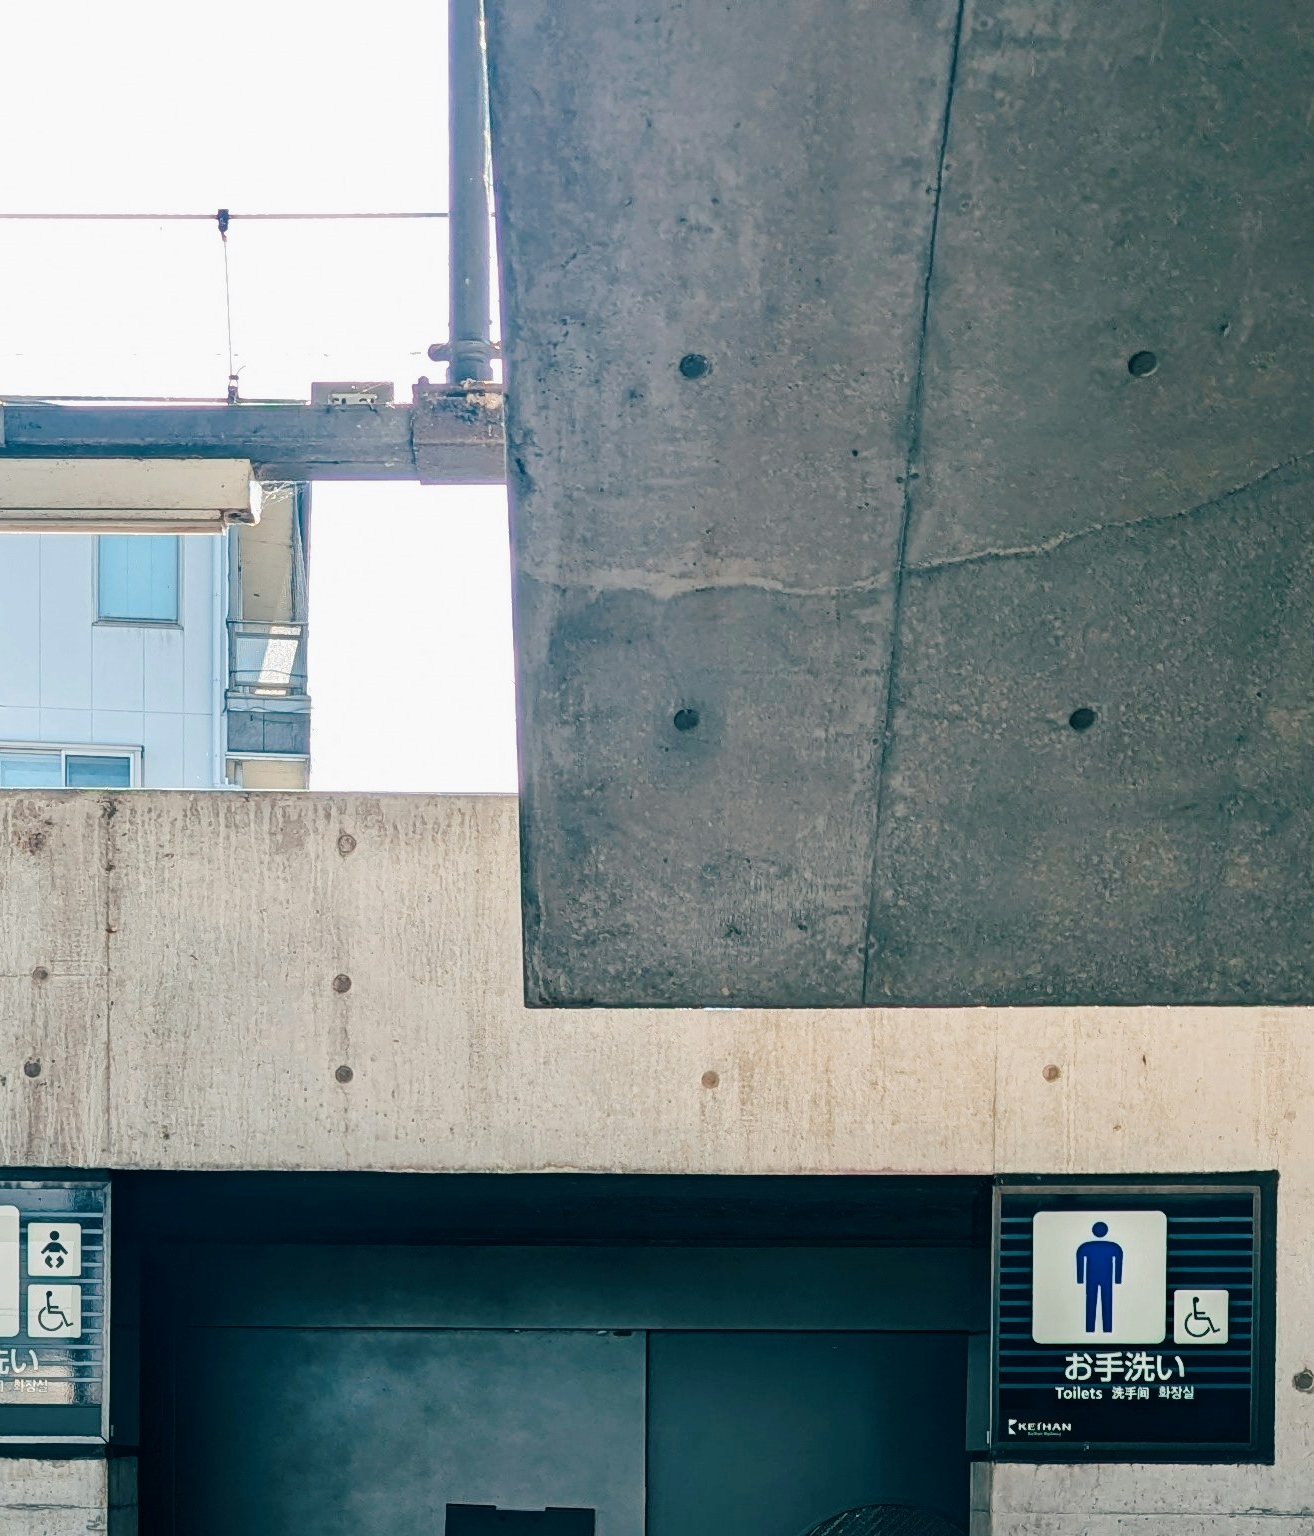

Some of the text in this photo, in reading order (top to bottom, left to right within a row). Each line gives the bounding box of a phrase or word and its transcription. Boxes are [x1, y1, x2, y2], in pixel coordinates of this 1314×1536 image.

[1065, 1351, 1185, 1382] お手洗い
[13, 1379, 48, 1393] 화장실
[1054, 1386, 1195, 1401] Toilets 洗手间 화장실
[1018, 1421, 1072, 1432] KEIHAN
